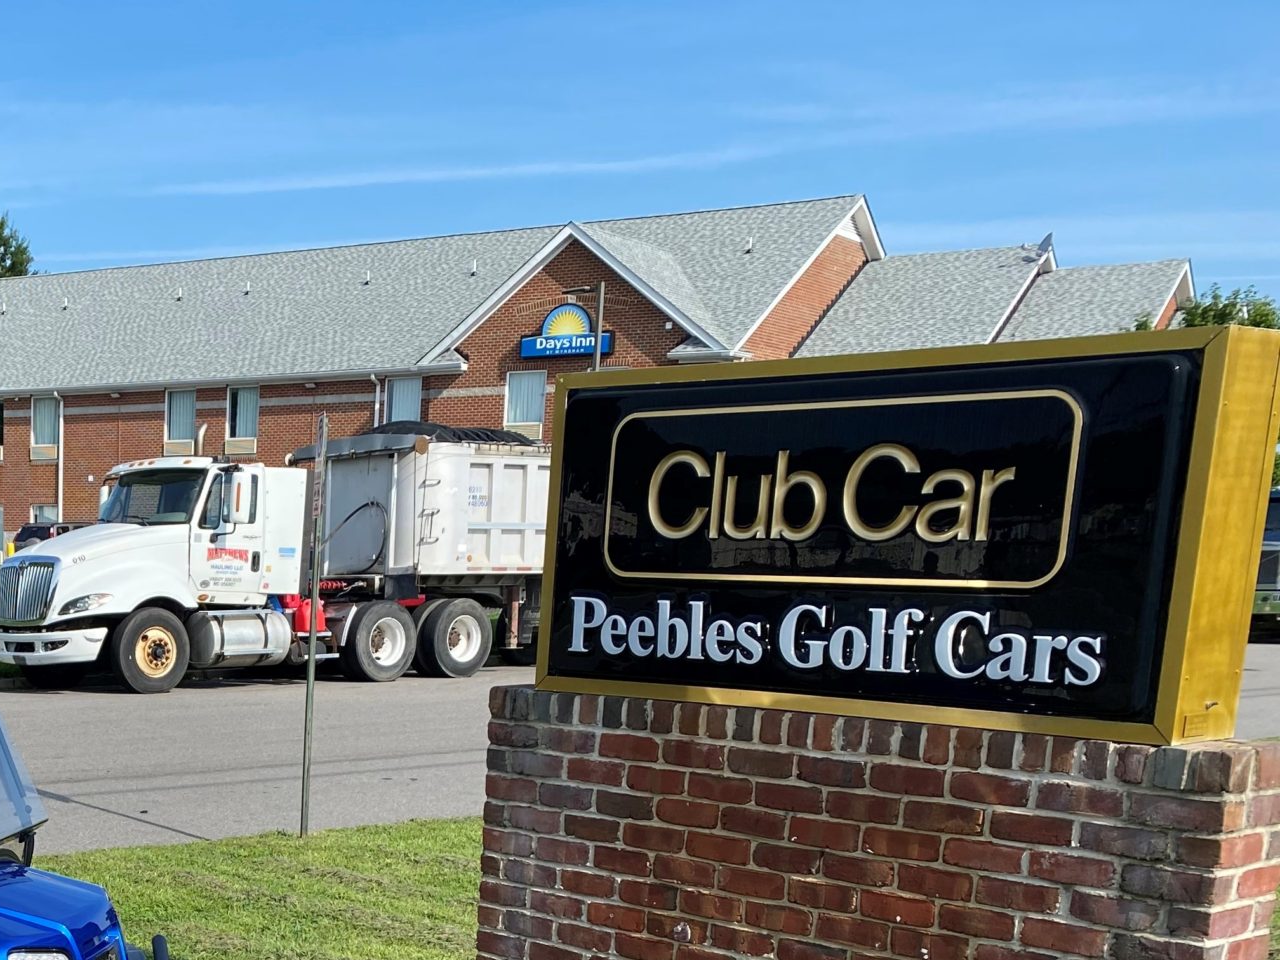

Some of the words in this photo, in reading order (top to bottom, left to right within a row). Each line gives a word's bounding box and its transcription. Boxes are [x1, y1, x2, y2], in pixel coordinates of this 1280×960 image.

[536, 338, 570, 350] Days
[572, 336, 595, 347] Inn
[648, 449, 827, 541] Club
[843, 443, 1016, 543] Car
[568, 596, 763, 665] Peebles
[779, 604, 925, 674] Golf
[935, 610, 1102, 686] Cars
